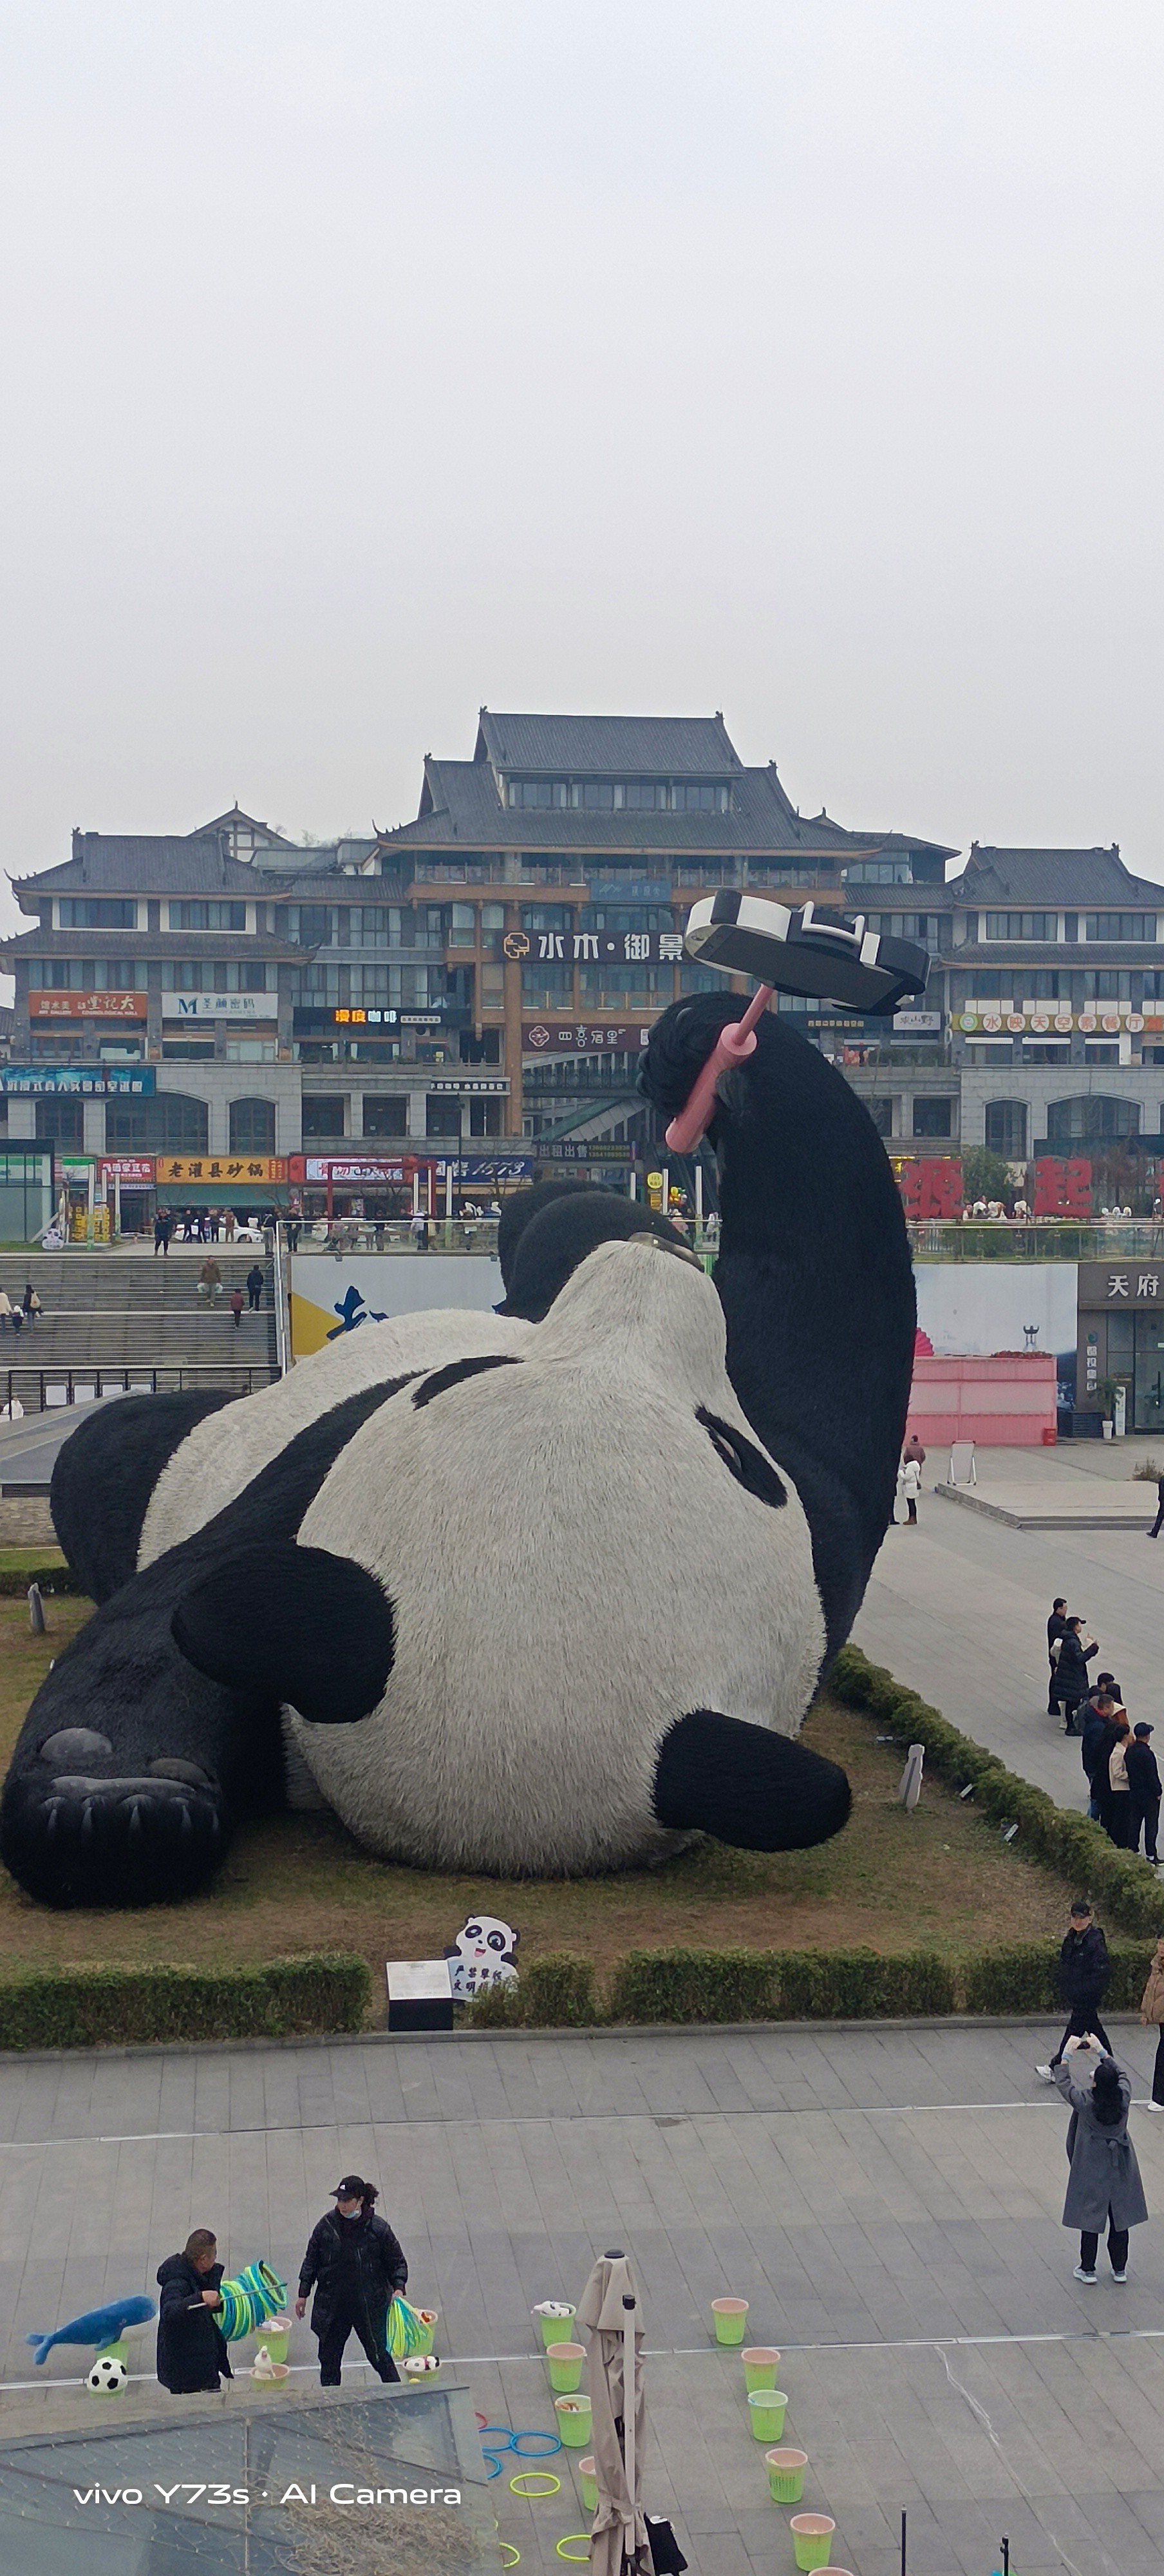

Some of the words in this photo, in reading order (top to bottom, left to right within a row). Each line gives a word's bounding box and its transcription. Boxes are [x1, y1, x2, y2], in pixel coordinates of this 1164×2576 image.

[538, 933, 682, 961] 水木·御景
[335, 1009, 397, 1023] 漫度咖啡
[540, 1144, 588, 1158] 出租出售
[169, 1161, 263, 1178] 老灌县砂锅
[1108, 1273, 1159, 1297] 天府
